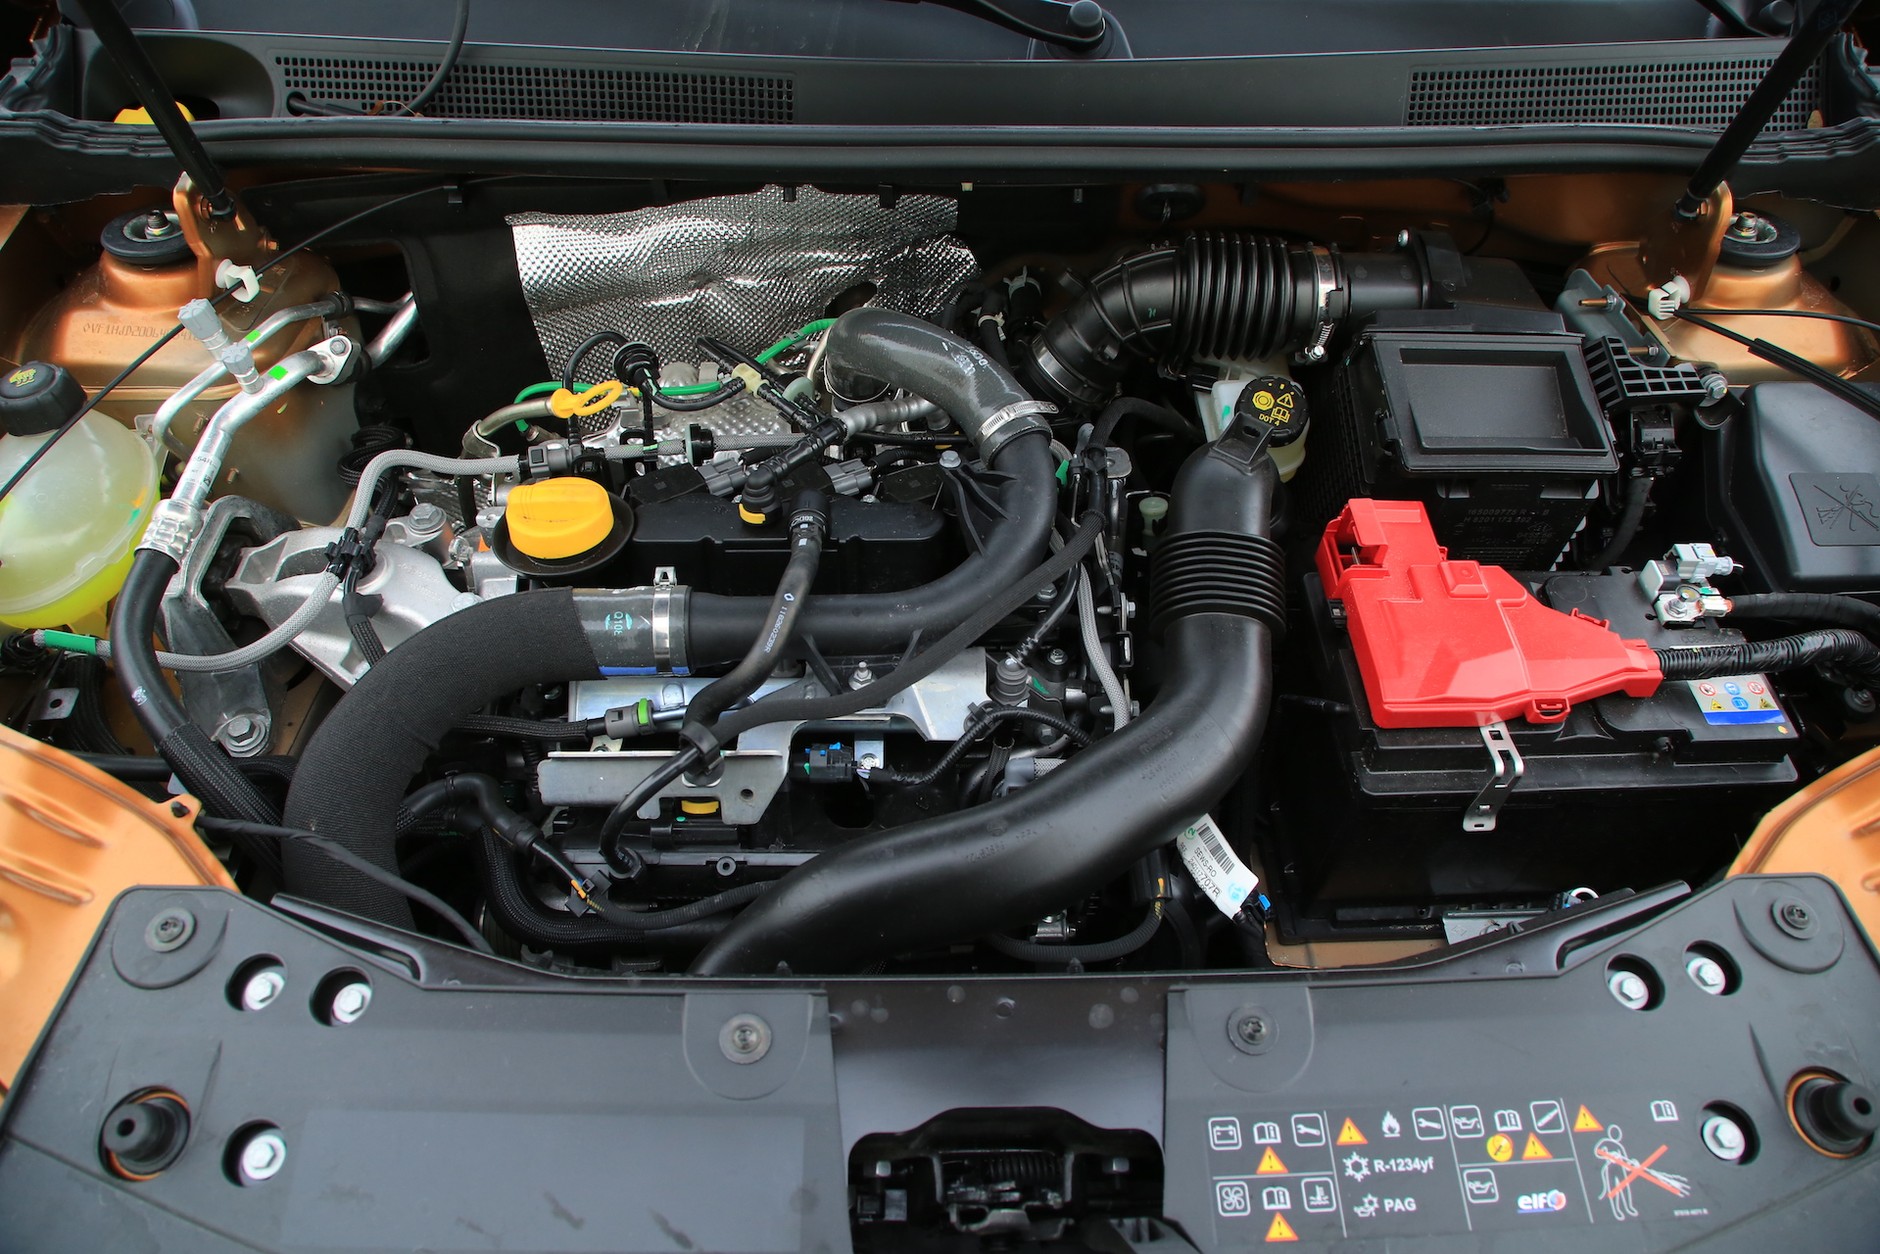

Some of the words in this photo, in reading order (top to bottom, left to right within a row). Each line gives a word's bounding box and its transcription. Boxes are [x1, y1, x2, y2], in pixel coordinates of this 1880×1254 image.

[1259, 413, 1274, 424] DOT
[1194, 847, 1218, 878] SEWS-RO
[1373, 1156, 1434, 1173] R-1234yf
[1384, 1197, 1417, 1212] PAG
[1517, 1191, 1549, 1211] elf
